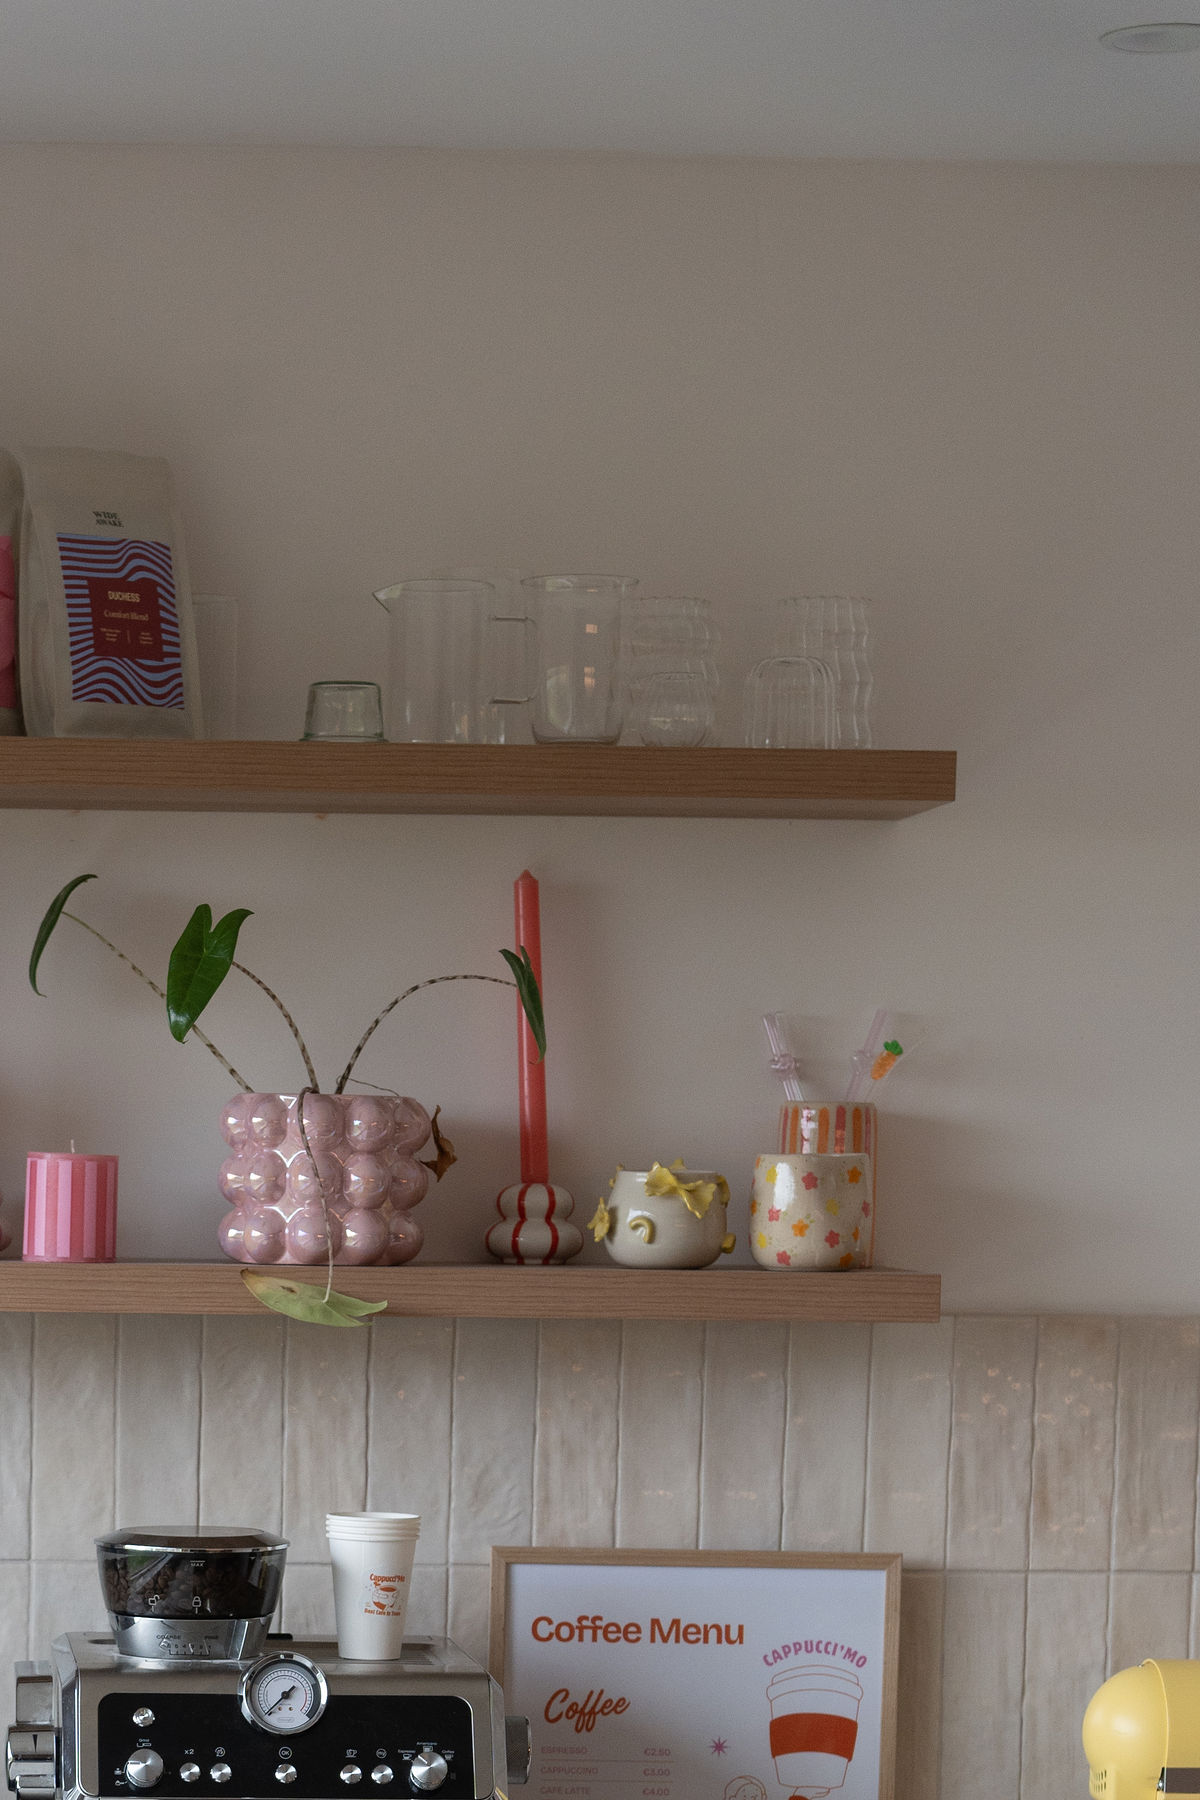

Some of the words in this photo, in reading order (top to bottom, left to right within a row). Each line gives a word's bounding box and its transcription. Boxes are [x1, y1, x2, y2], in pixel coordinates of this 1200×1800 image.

[92, 511, 119, 520] WIDE
[95, 519, 125, 528] AWAKE
[108, 590, 141, 602] DUCHESS
[104, 609, 129, 619] Comfort
[129, 611, 149, 621] Blend
[531, 1615, 642, 1643] Coffee
[650, 1618, 744, 1645] Menu
[762, 1639, 867, 1668] CAPPUCCI'MO
[543, 1687, 632, 1734] Coffee
[540, 1746, 588, 1755] ESPRESSO
[643, 1747, 671, 1756] €2.50
[540, 1766, 599, 1775] CAPPUCCINO
[643, 1768, 671, 1776] €3.00
[564, 1786, 591, 1795] LATTE
[642, 1787, 670, 1796] €4.00
